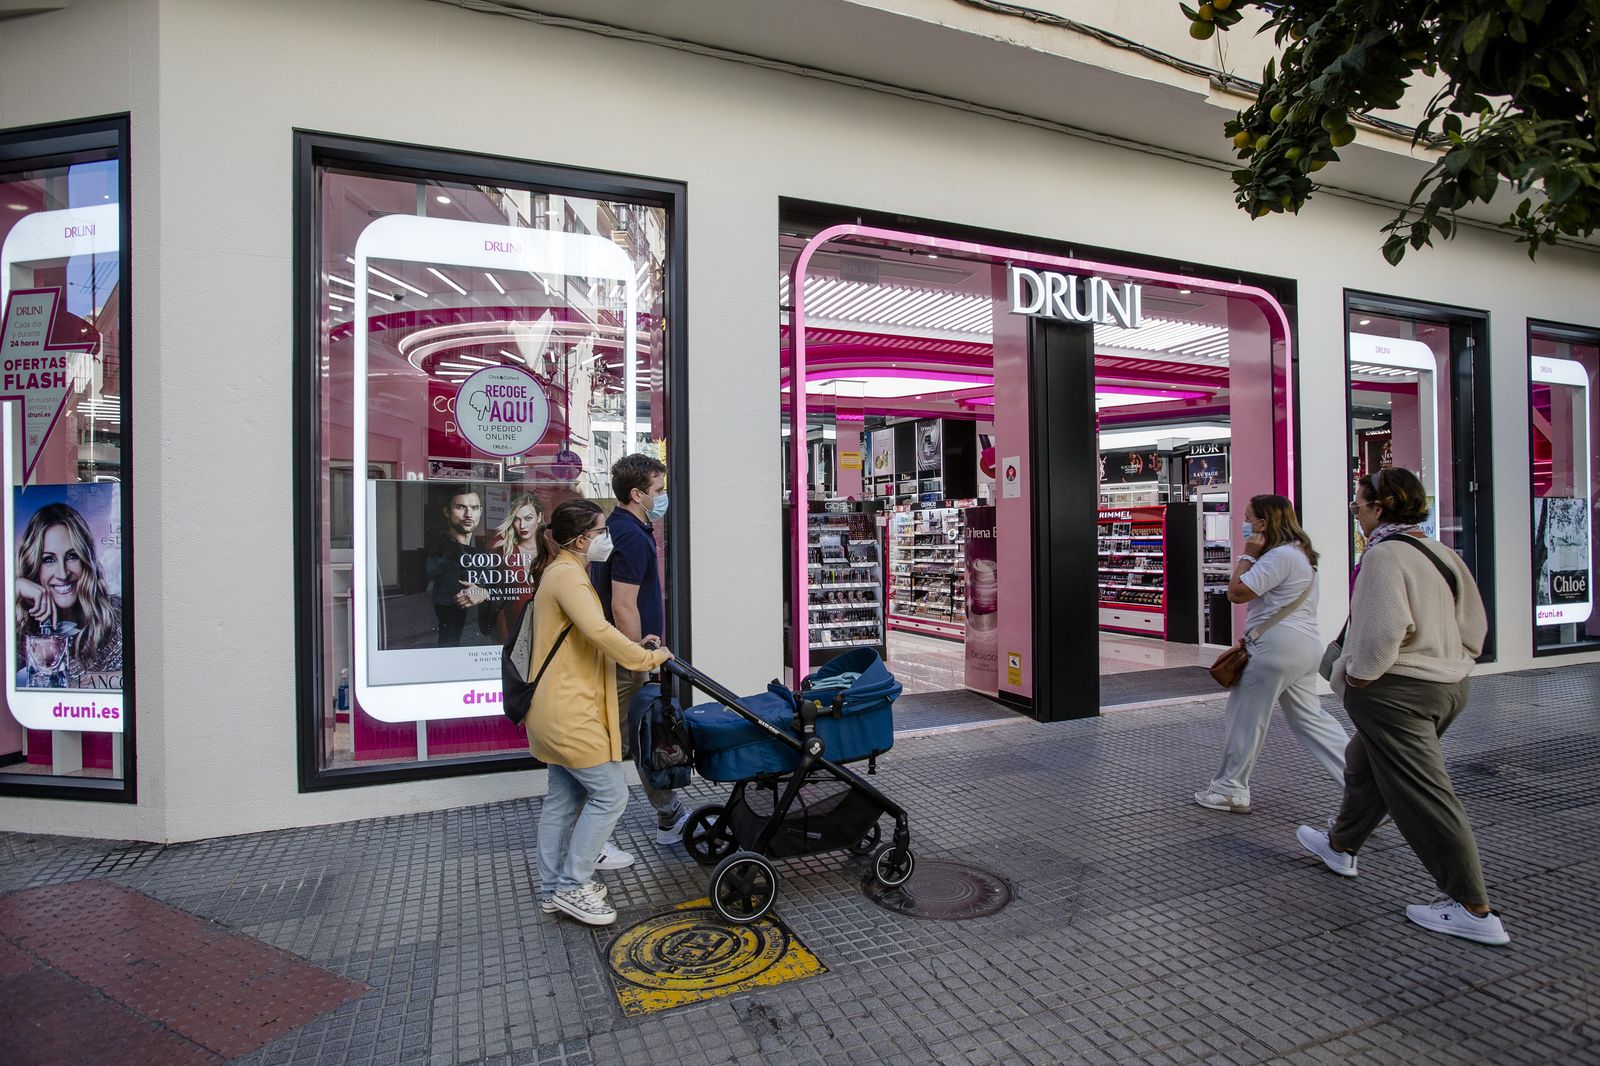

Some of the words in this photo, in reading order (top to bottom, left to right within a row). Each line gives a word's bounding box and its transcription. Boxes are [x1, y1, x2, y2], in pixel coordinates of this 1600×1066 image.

[64, 224, 96, 239] DRUNI
[484, 240, 522, 254] DRUNI
[1006, 265, 1143, 329] DRUNI
[16, 305, 43, 316] DRUNI
[3, 356, 67, 371] OFERTAS
[4, 371, 66, 390] FLASH
[485, 384, 527, 399] RECOGE
[489, 396, 534, 423] AQUÍ
[477, 424, 489, 432] TU
[491, 424, 523, 433] PEDIDO
[485, 432, 517, 441] ONLINE
[1190, 443, 1220, 455] DIOR
[1193, 470, 1219, 478] SAUVAGE
[824, 501, 853, 511] GOSH
[1099, 510, 1131, 519] RIMMEL
[972, 526, 991, 539] Irena
[460, 553, 502, 568] GOOD
[504, 553, 532, 568] GIR
[466, 569, 502, 585] BAD
[503, 569, 529, 585] BO
[1553, 575, 1586, 593] Chloé
[460, 588, 503, 596] CAROLINA
[1537, 609, 1564, 619] druni.es
[52, 701, 120, 720] druni.es
